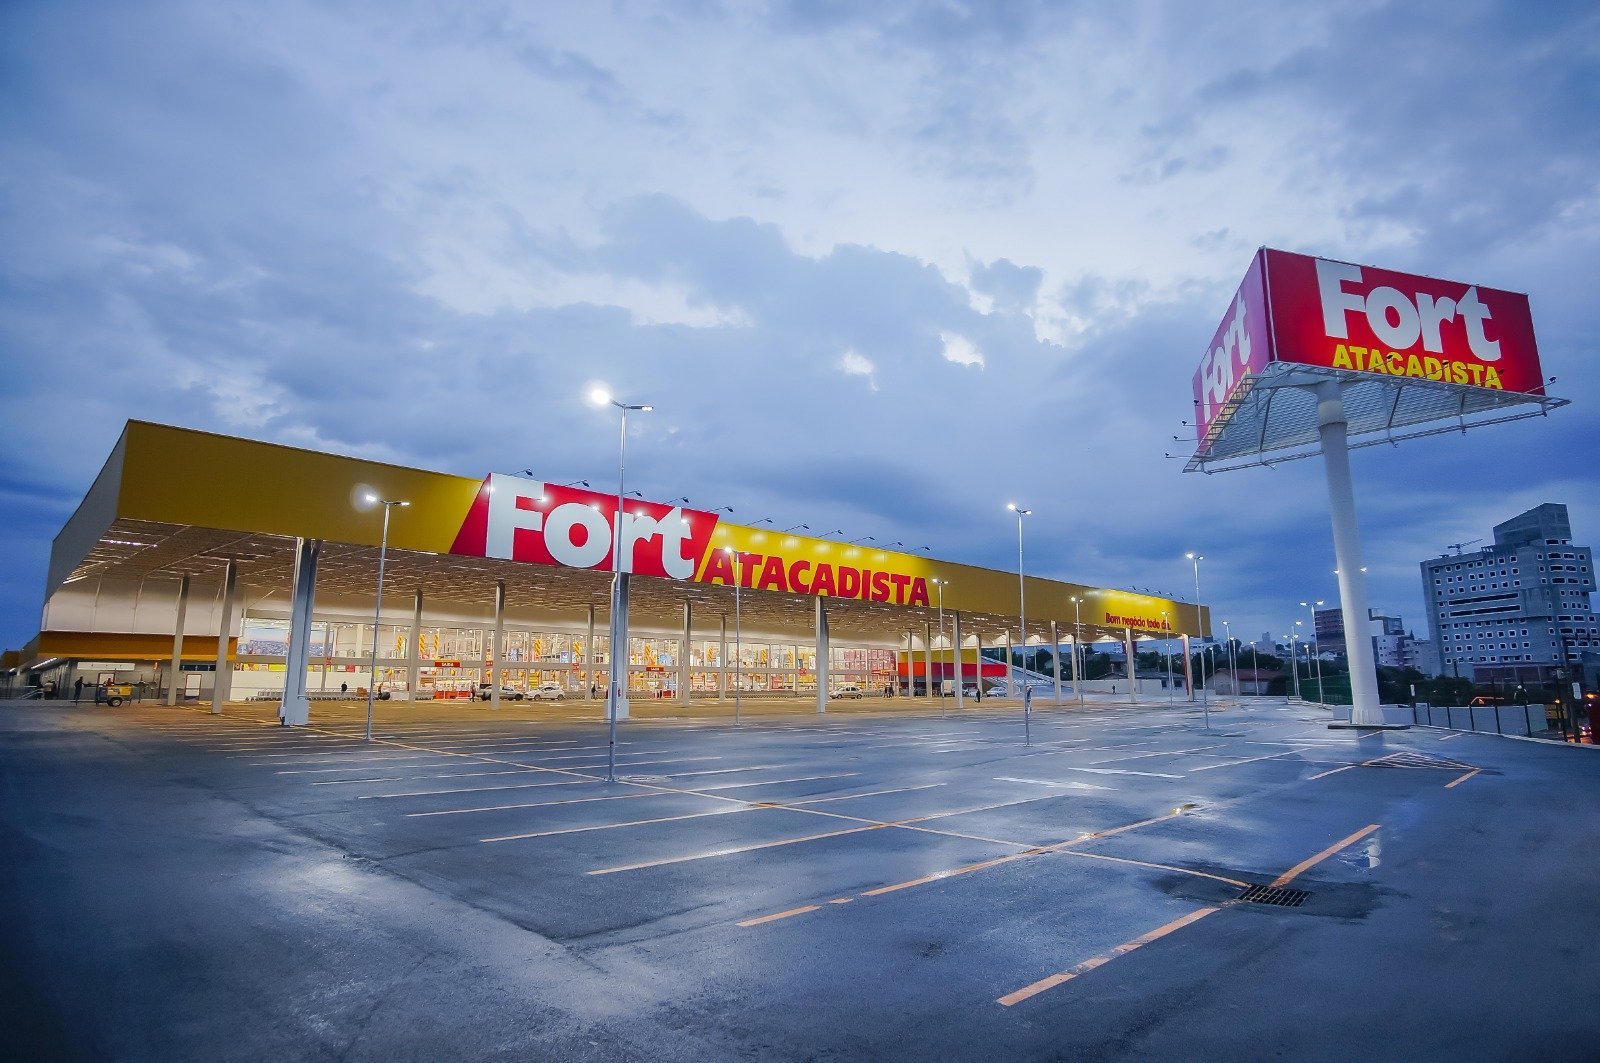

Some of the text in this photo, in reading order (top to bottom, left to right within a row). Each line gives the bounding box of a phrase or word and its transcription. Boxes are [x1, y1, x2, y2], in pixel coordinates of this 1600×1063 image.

[1201, 290, 1251, 425] Fort
[1316, 259, 1501, 361] Fort
[1333, 344, 1503, 389] ATACADISTA
[486, 473, 930, 606] Fort ATACADISTA
[1106, 612, 1121, 624] Bom
